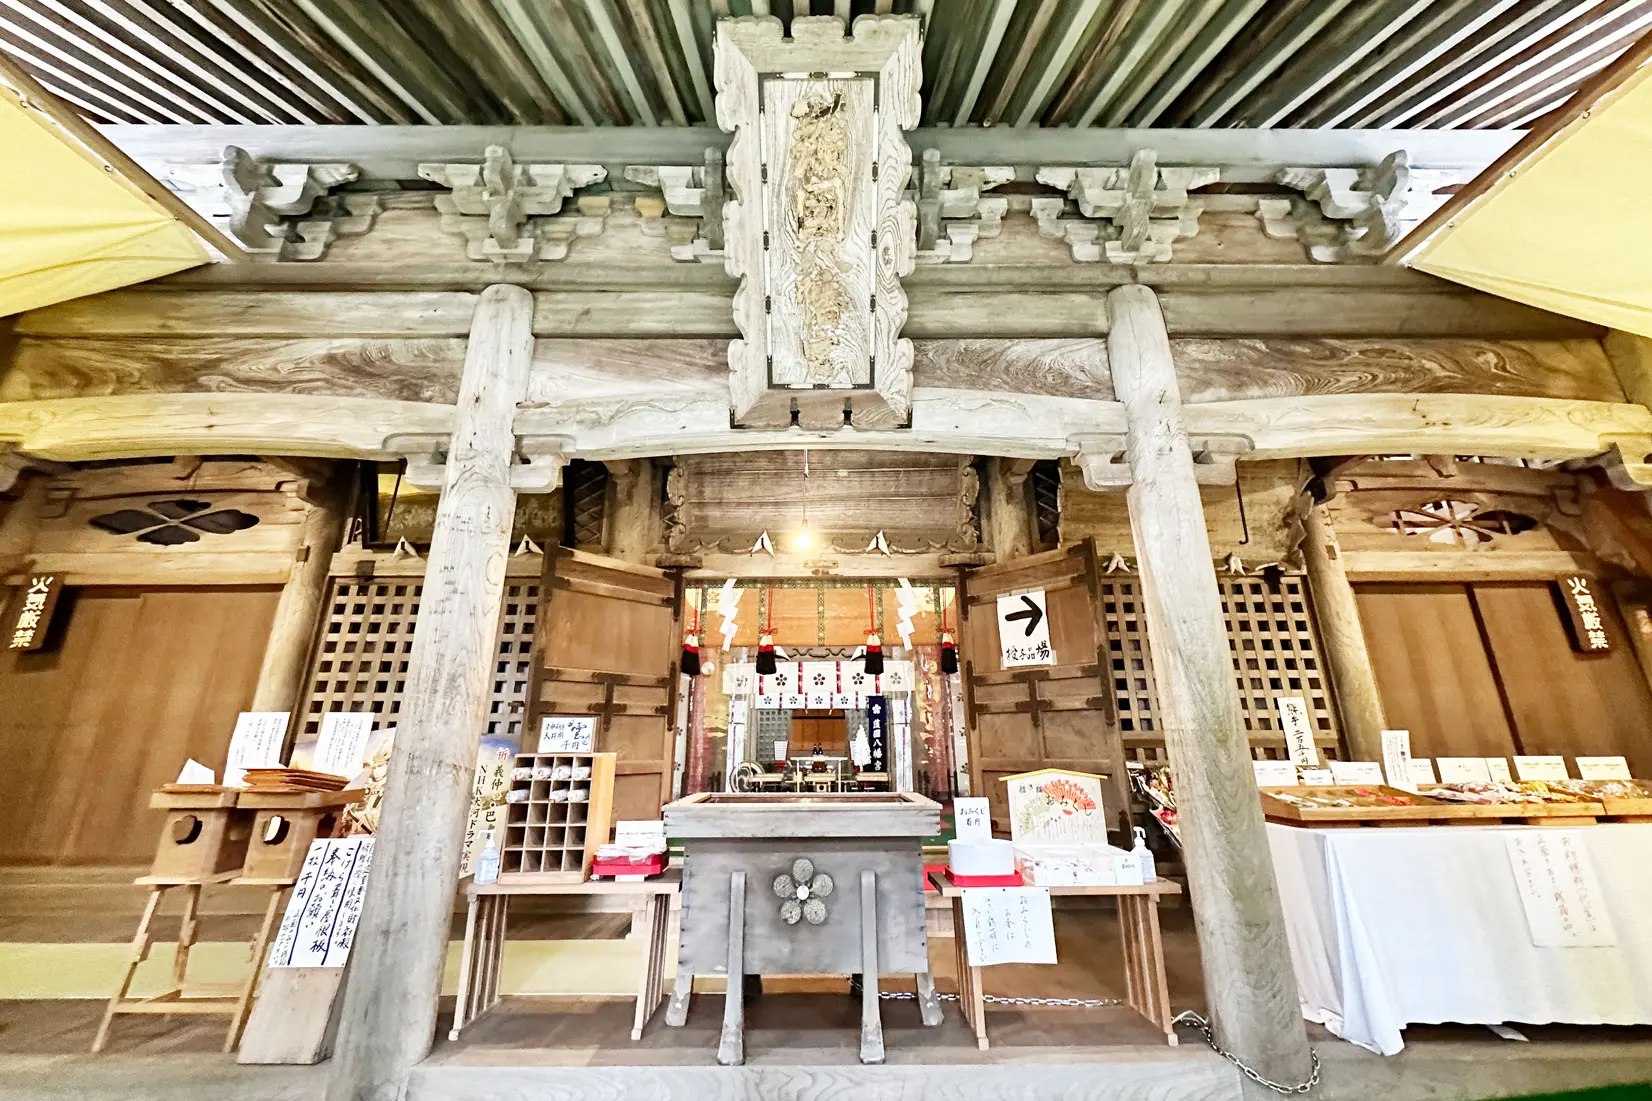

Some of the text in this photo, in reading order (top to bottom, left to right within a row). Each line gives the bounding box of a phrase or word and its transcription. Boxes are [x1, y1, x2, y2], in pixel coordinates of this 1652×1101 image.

[9, 576, 54, 648] 火気厳禁
[1566, 576, 1609, 649] 火気厳禁
